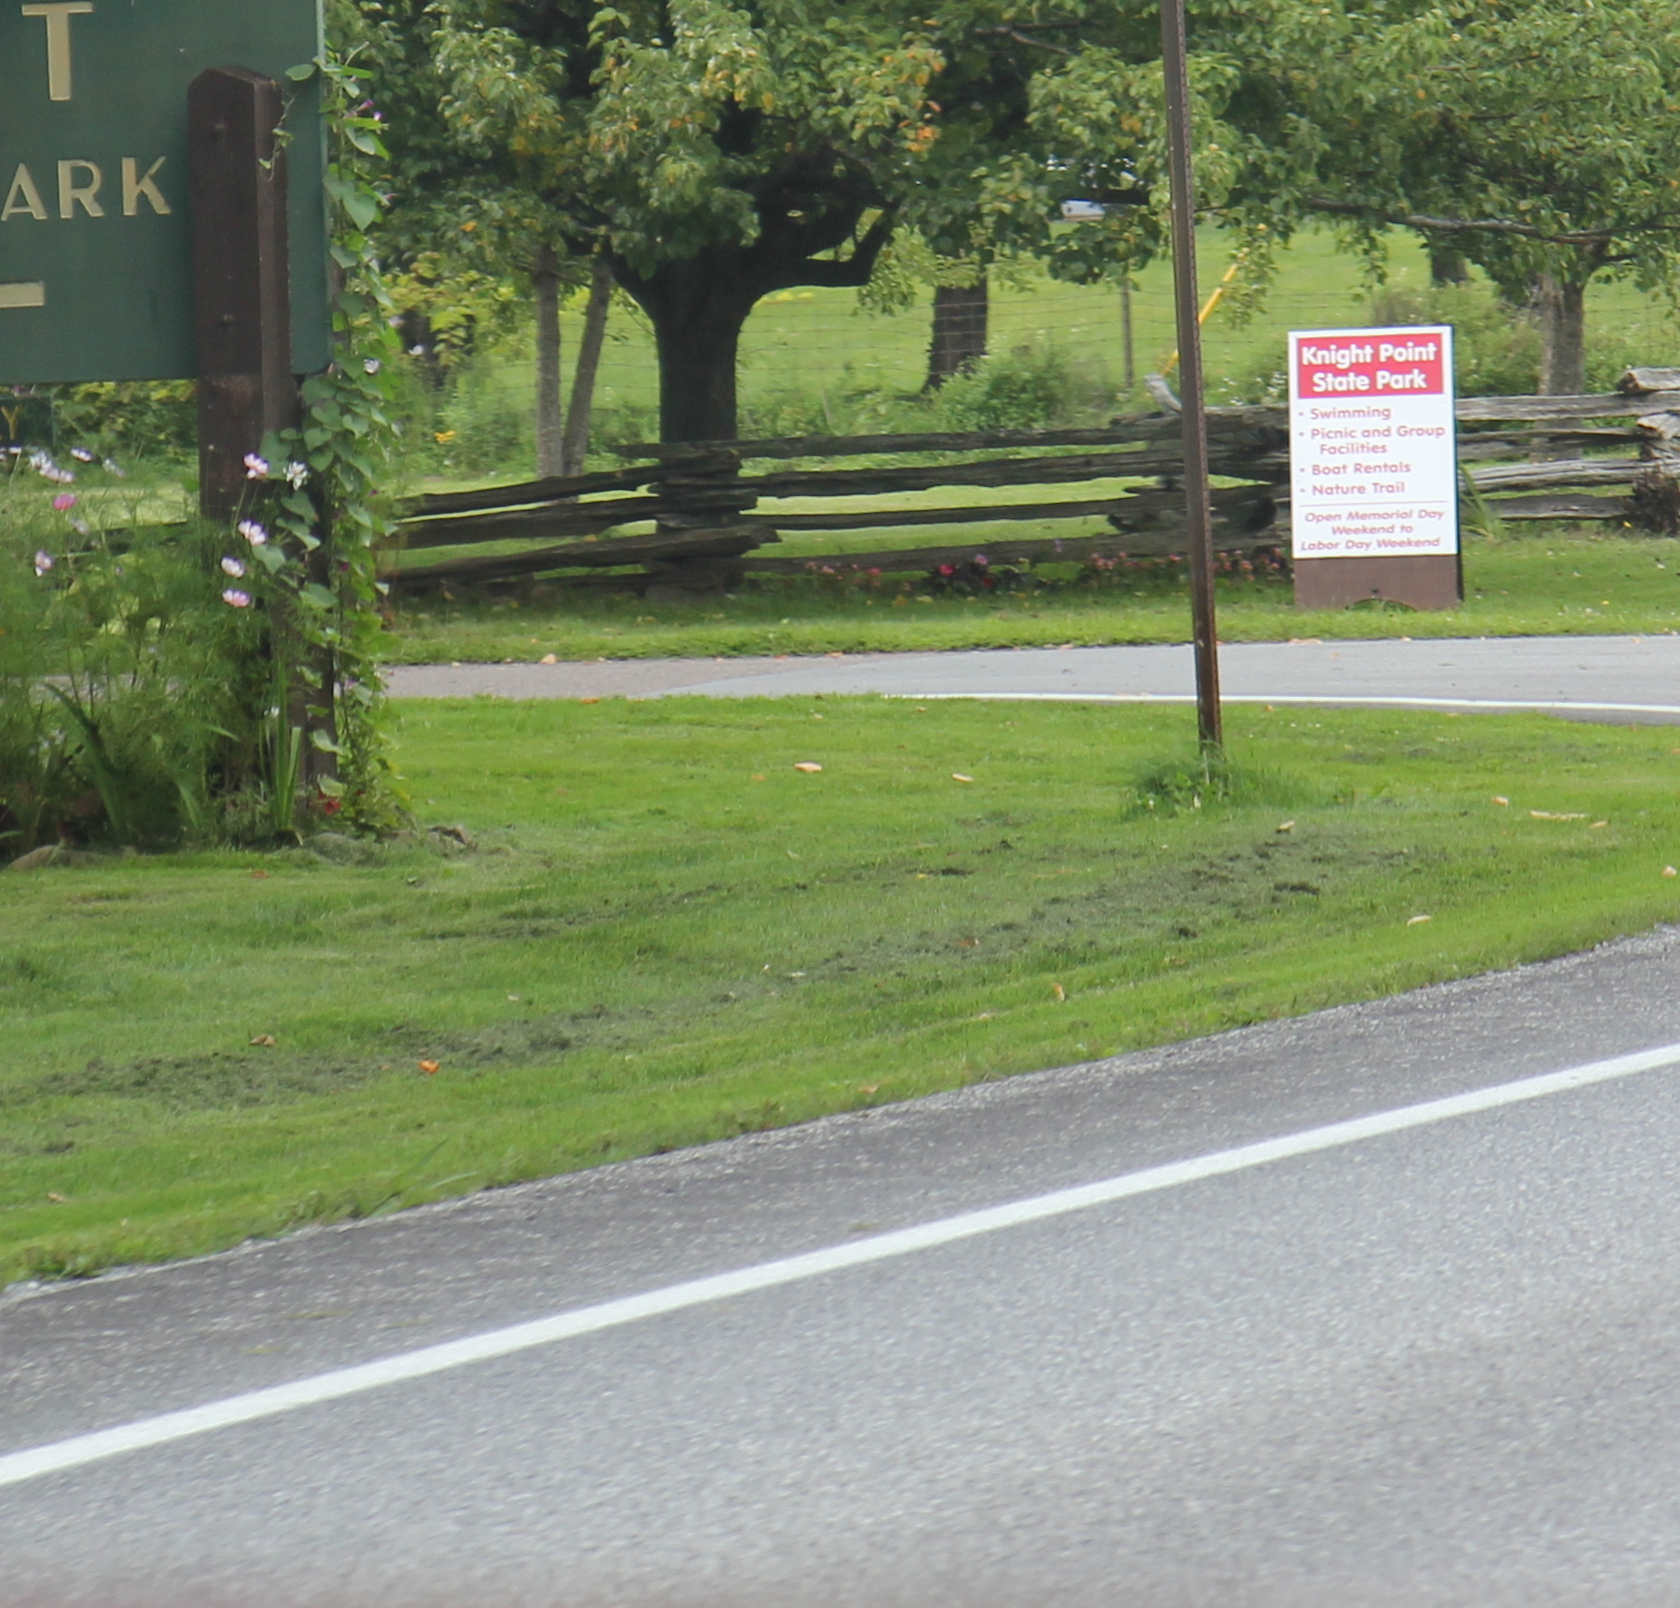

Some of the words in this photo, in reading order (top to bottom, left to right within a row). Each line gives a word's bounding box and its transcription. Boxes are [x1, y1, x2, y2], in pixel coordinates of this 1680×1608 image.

[1302, 344, 1373, 369] Knight
[1379, 342, 1437, 363] Point
[1312, 372, 1370, 392] State
[1376, 369, 1427, 390] Park
[1310, 406, 1391, 420] Swimming
[1311, 427, 1357, 439] Picnic
[1361, 426, 1391, 438] and
[1397, 425, 1445, 438] Group
[1320, 442, 1387, 455] Facilities
[1312, 463, 1348, 475] Boat
[1354, 461, 1411, 474] Rentals
[1312, 484, 1366, 496] Nature
[1371, 481, 1405, 494] Trail
[1305, 512, 1342, 524] Open
[1347, 509, 1413, 521] Memorial
[1418, 509, 1445, 521] Day
[1331, 524, 1395, 535] Weekend
[1401, 524, 1413, 533] to
[1301, 540, 1339, 551] Labor
[1345, 539, 1371, 551] Day
[1377, 537, 1440, 548] Weekend
